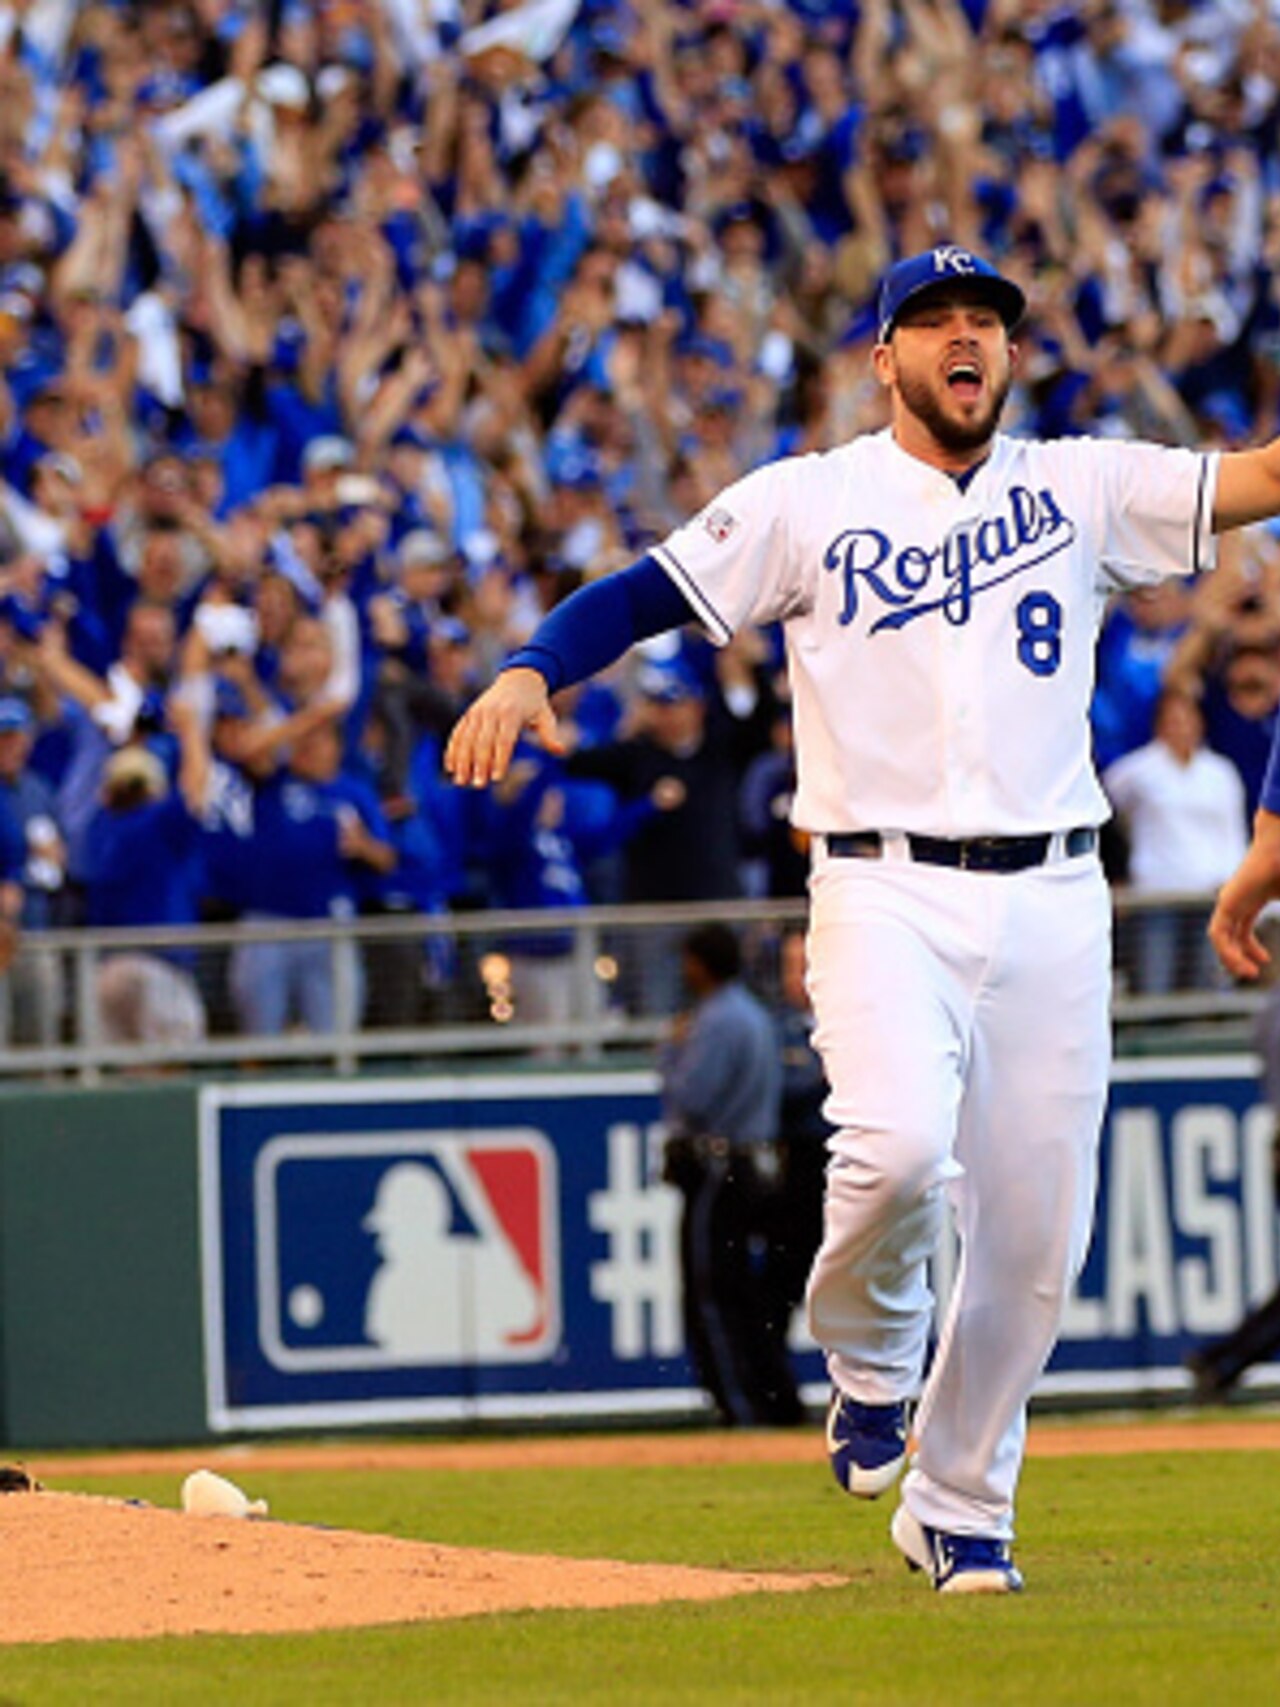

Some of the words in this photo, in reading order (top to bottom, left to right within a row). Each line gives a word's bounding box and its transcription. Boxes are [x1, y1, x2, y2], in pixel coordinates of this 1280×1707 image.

[933, 246, 976, 275] KC
[823, 486, 1076, 630] Royals
[1016, 589, 1062, 678] 8
